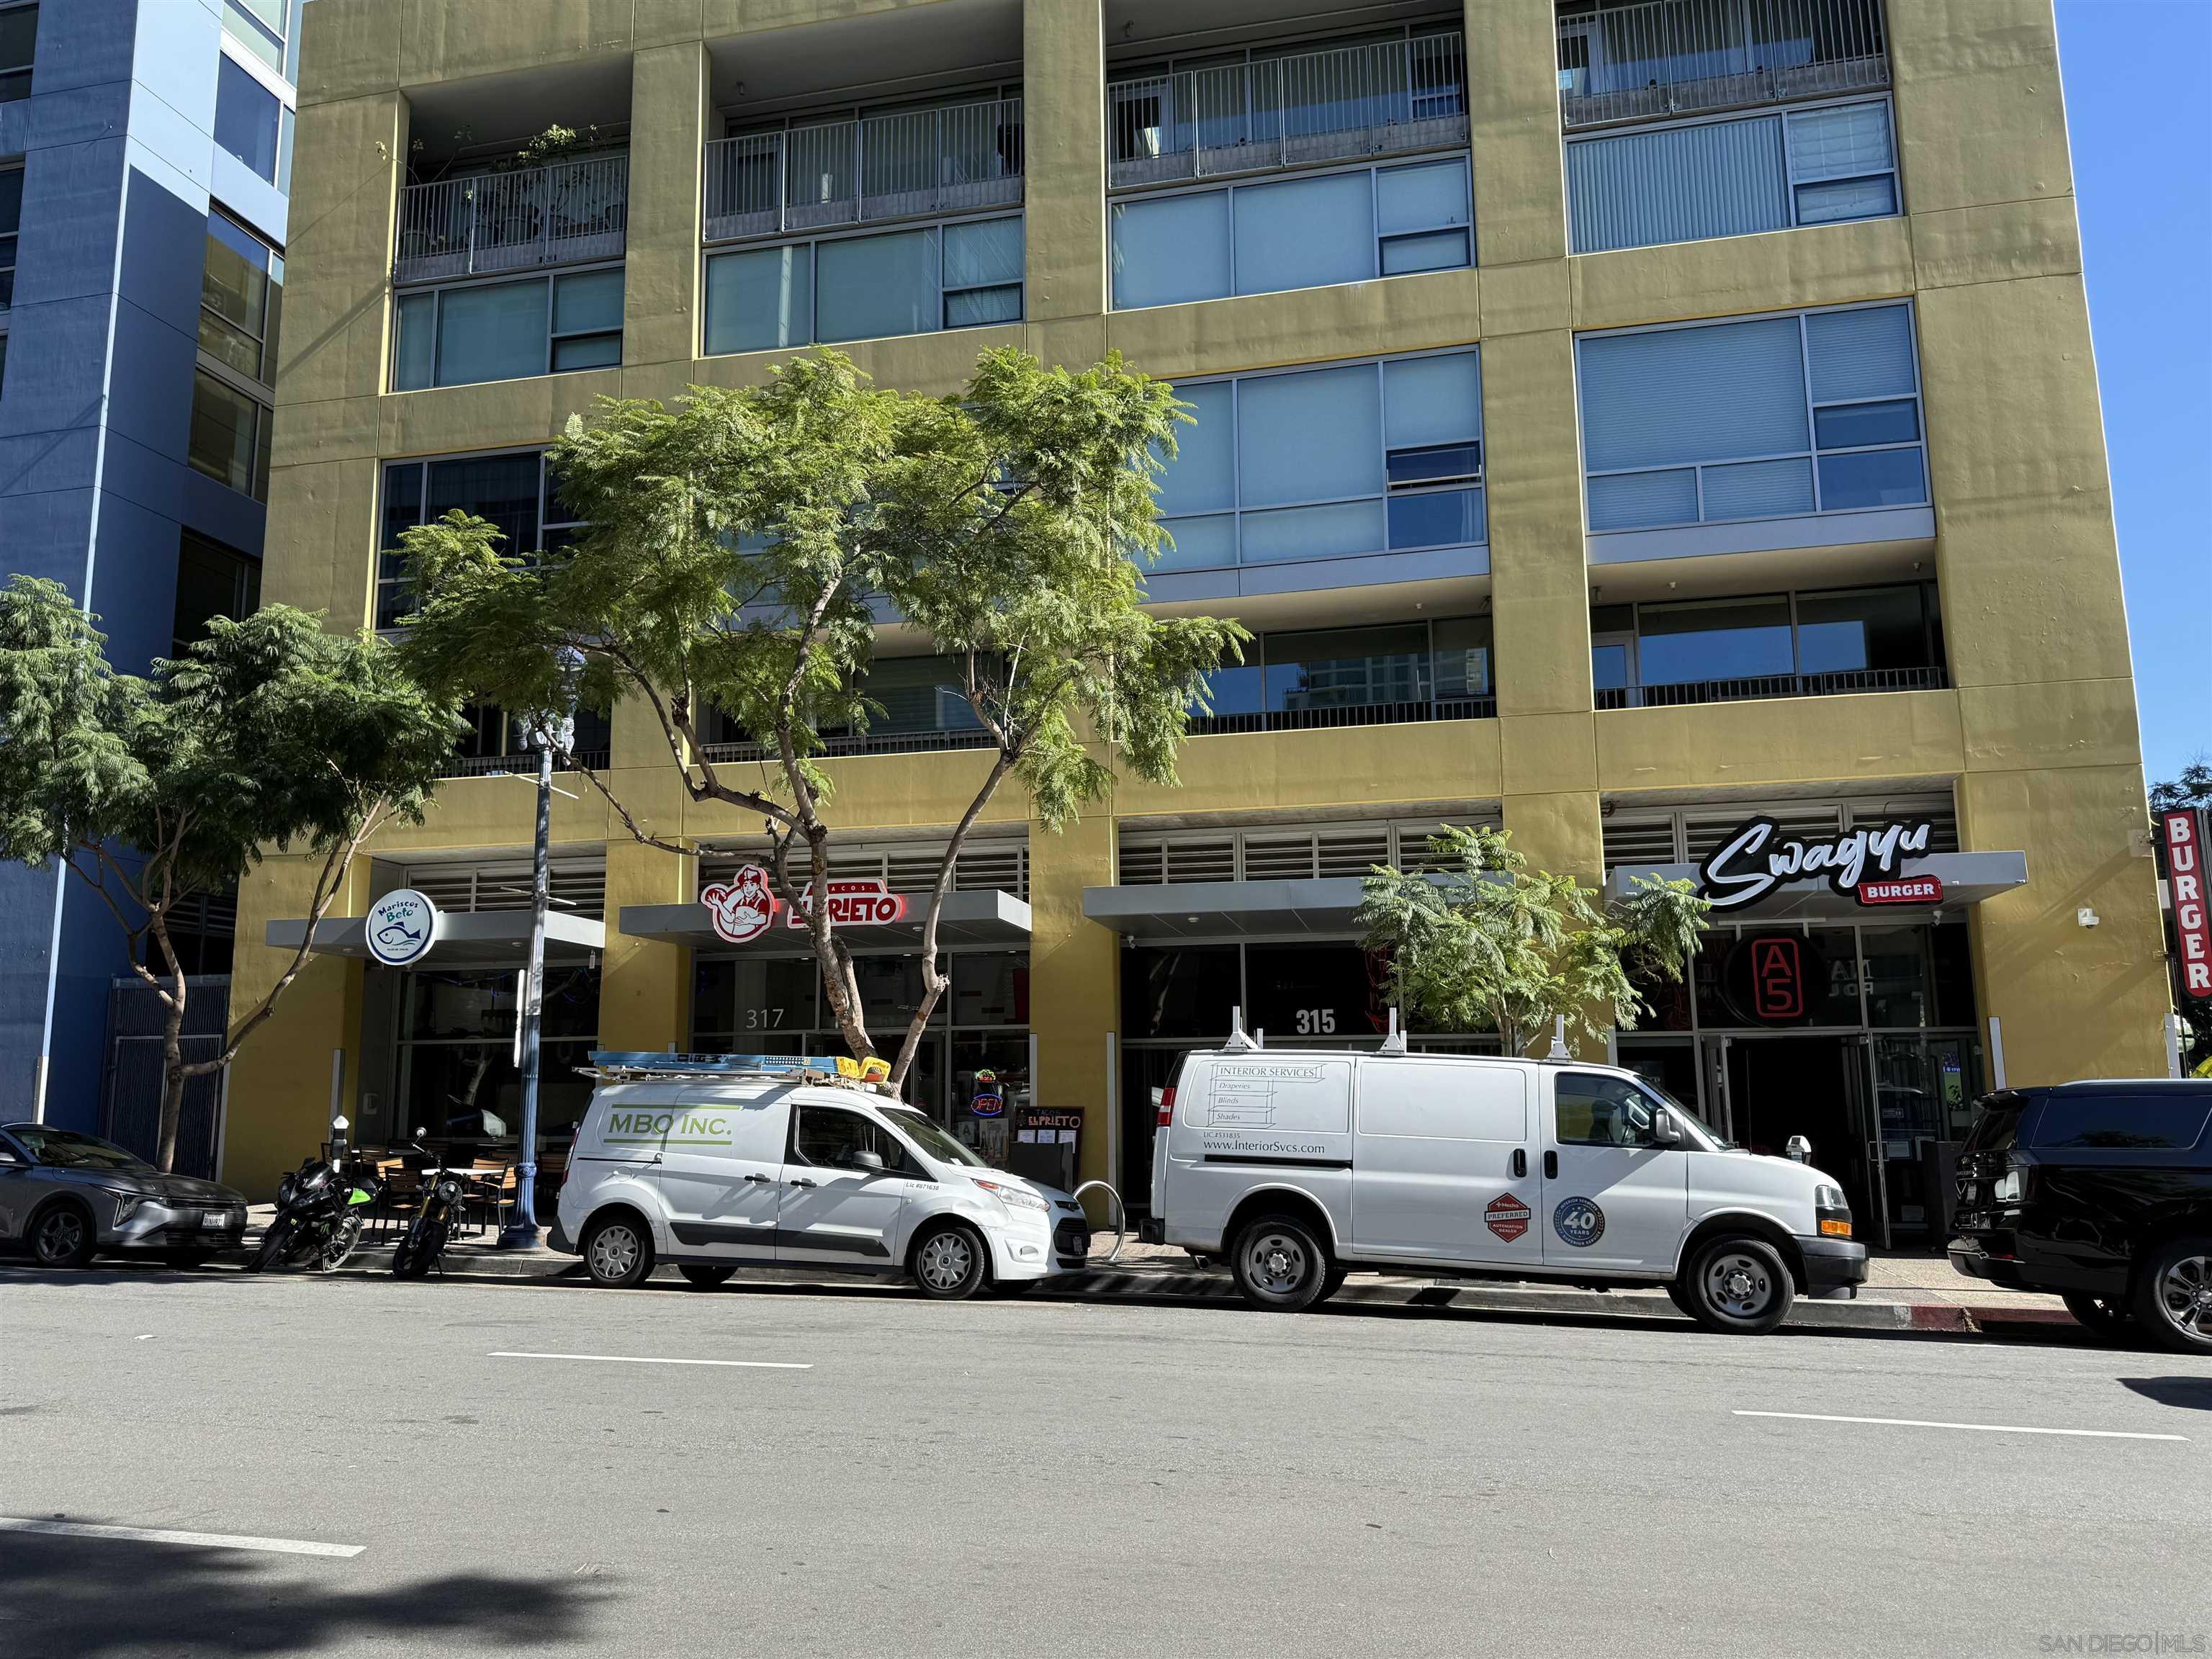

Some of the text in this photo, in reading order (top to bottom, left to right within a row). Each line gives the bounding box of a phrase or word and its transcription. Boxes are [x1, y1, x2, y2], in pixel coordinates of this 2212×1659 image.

[1704, 823, 1930, 906] Swagyu
[1867, 883, 1936, 899] BURGER
[378, 901, 418, 916] Mariscos
[828, 897, 896, 922] RIETO
[2167, 817, 2211, 989] BURGER
[386, 907, 413, 922] Beto
[746, 1008, 784, 1028] 317
[1296, 1009, 1336, 1034] 315
[1220, 1067, 1314, 1077] INTERIOR SERVICES
[971, 1098, 1003, 1111] OPEN
[608, 1114, 674, 1134] MBO
[1203, 1141, 1325, 1154] www.InteriorSvcs.com
[1488, 1211, 1528, 1220] PREFERRED
[1563, 1211, 1596, 1230] 40
